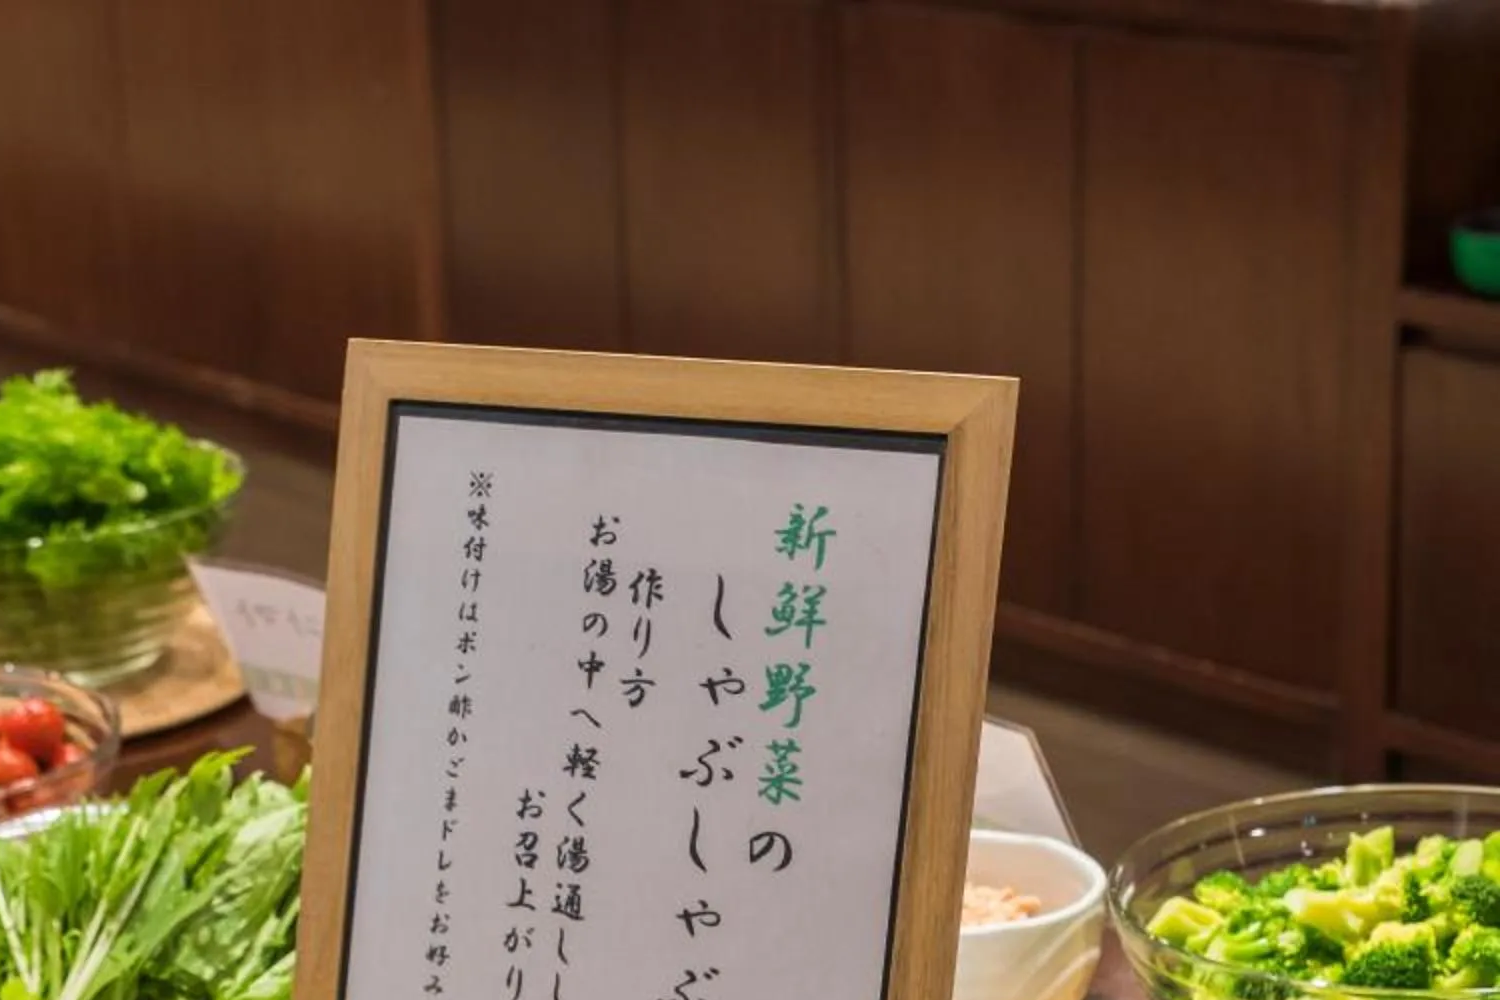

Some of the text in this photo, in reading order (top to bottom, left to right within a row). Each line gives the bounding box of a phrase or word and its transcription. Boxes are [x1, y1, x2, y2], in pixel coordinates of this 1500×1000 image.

[620, 567, 664, 708] 作り方
[749, 503, 836, 872] 新鮮野菜の
